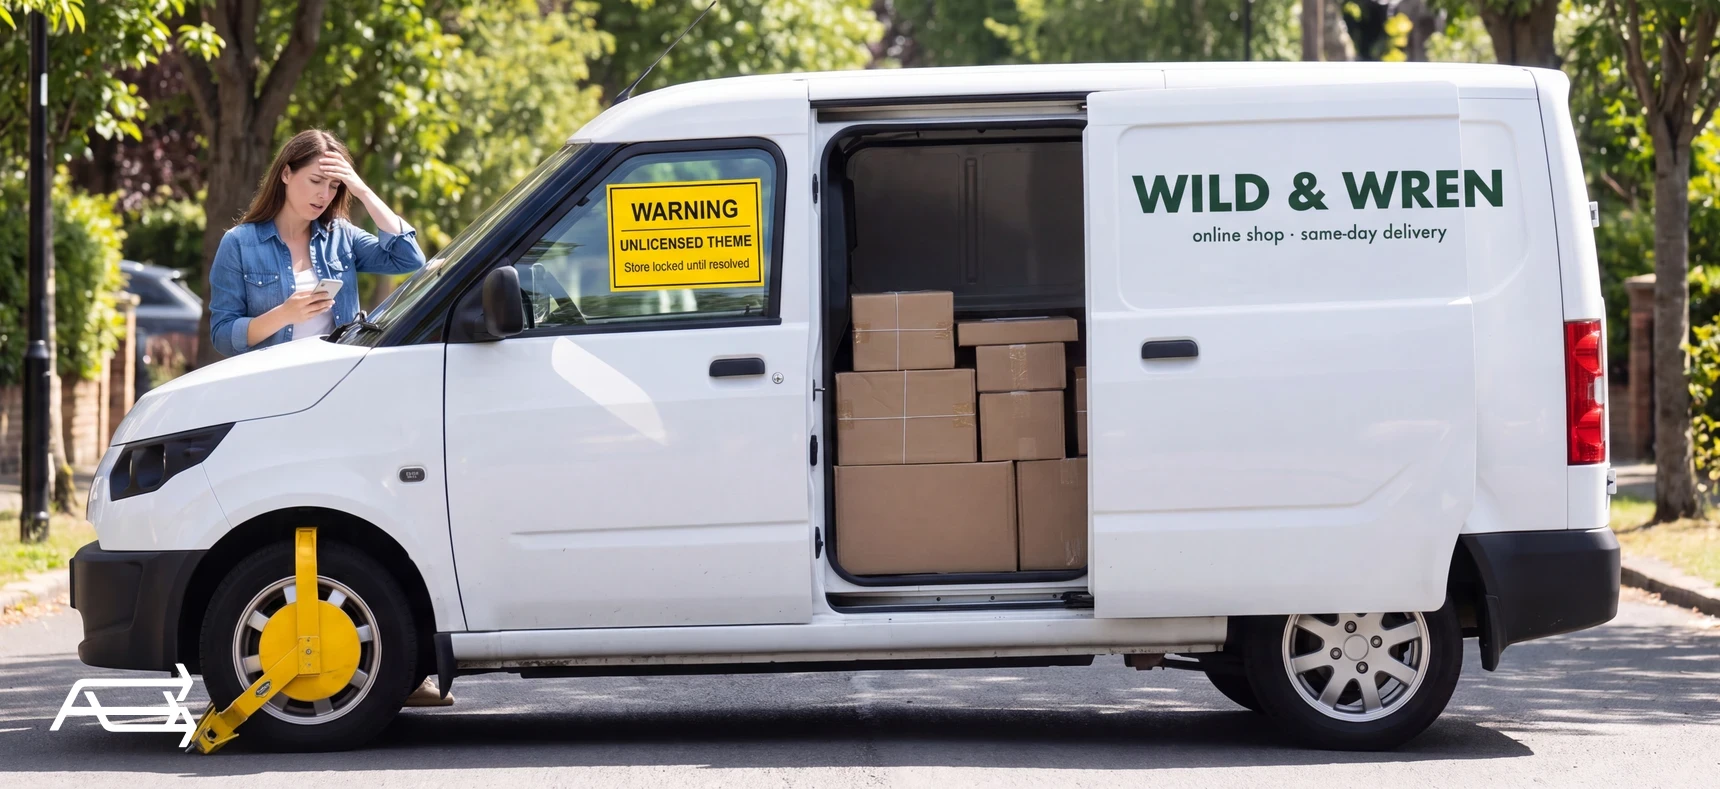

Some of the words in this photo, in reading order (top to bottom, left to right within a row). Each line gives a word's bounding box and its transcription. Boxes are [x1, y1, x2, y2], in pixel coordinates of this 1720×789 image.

[1132, 174, 1270, 213] WILD
[1287, 171, 1329, 211] &
[1342, 169, 1504, 209] WREN
[631, 199, 738, 222] WARNING
[620, 236, 704, 251] UNLICENSED
[707, 234, 752, 248] THEME
[1192, 225, 1241, 243] online
[1246, 225, 1285, 246] shop
[1300, 223, 1378, 245] same-day
[1382, 222, 1448, 244] delivery
[624, 261, 650, 273] Store
[652, 260, 684, 272] locked
[686, 259, 707, 271] until
[709, 258, 750, 270] resolved
